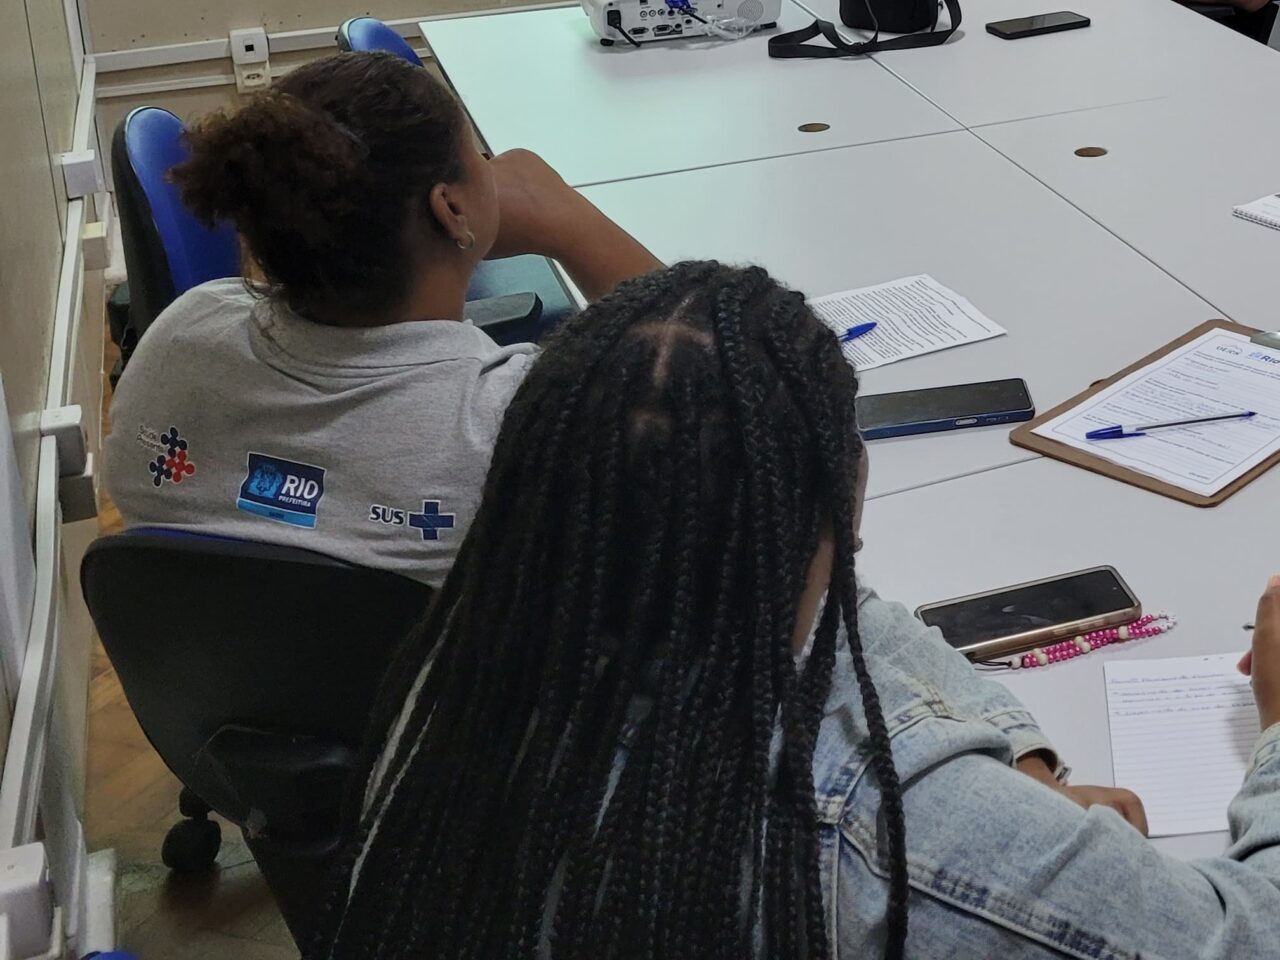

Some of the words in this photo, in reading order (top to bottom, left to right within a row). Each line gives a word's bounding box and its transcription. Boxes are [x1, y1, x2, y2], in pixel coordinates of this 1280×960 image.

[1260, 354, 1280, 365] Rio
[281, 474, 319, 499] RIO
[278, 495, 312, 508] PREFEITURA
[369, 505, 405, 526] SUS
